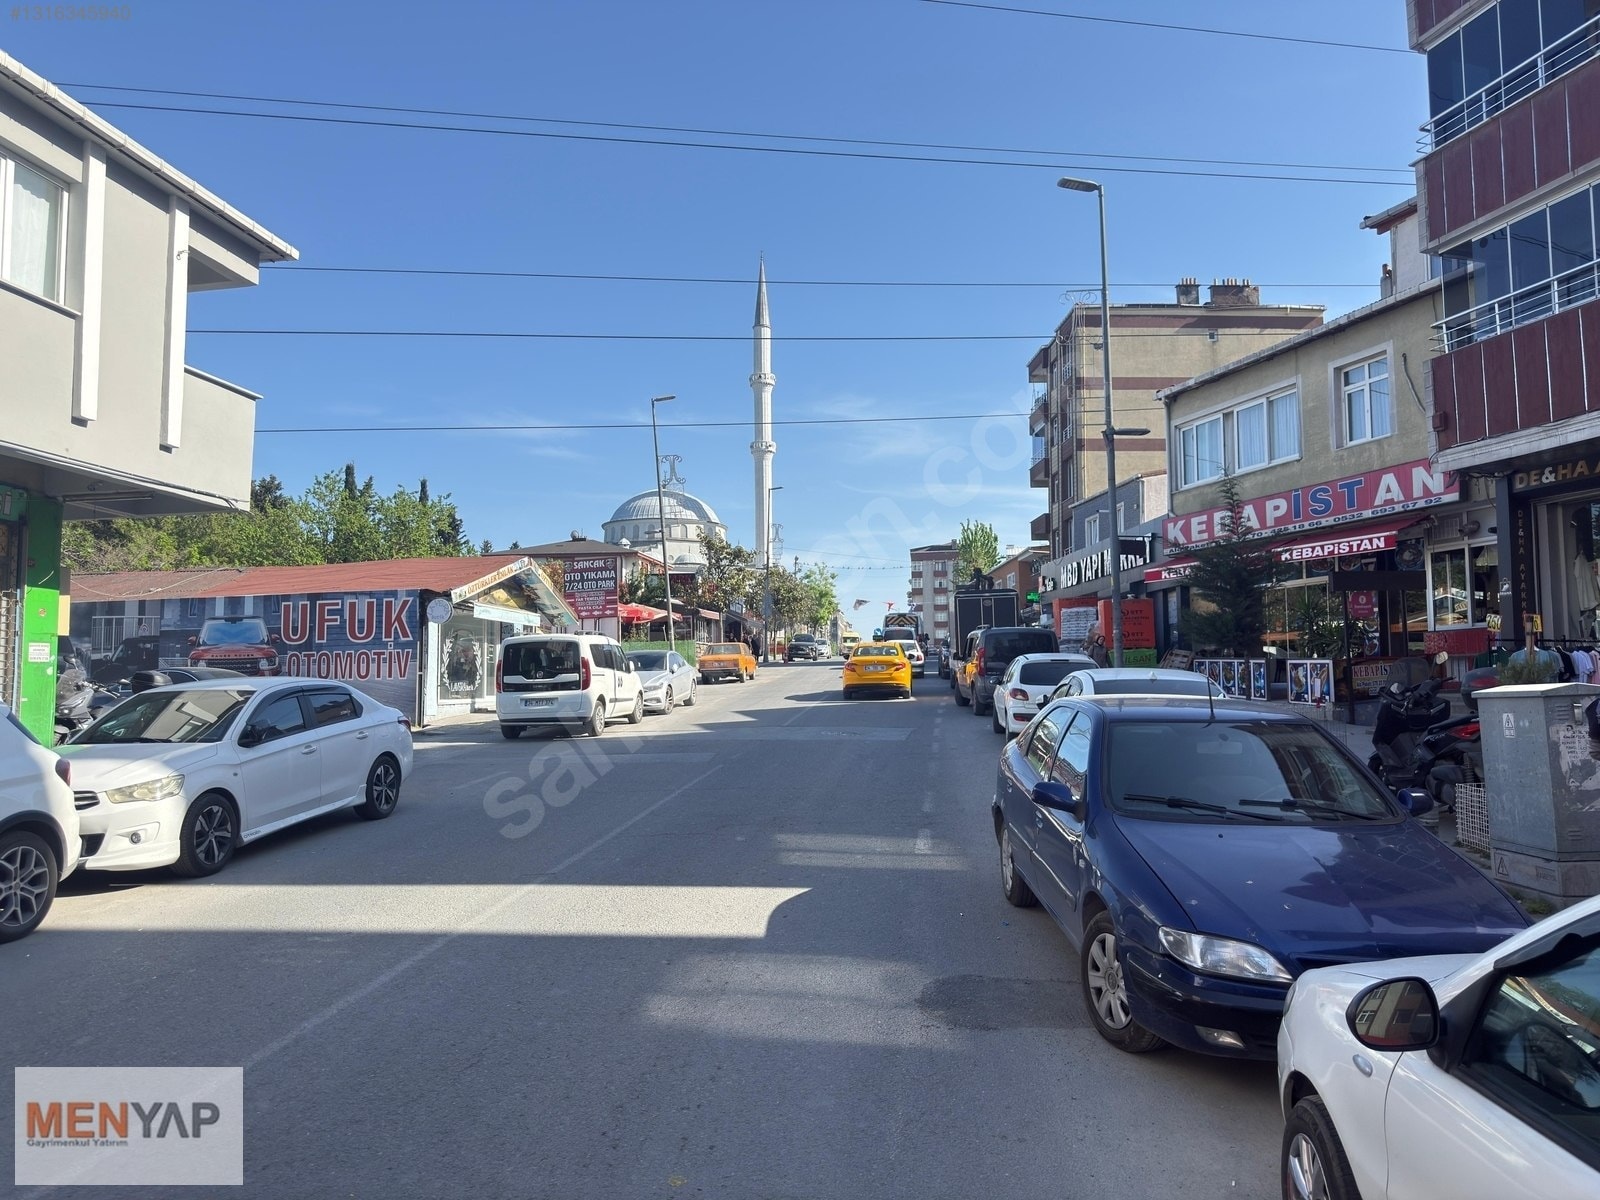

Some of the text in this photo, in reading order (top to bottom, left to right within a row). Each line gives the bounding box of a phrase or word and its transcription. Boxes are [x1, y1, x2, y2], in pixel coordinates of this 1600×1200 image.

[1515, 460, 1590, 490] DE&HA
[1308, 519, 1322, 528] 66
[1333, 512, 1364, 522] 0532
[1371, 505, 1396, 516] 693
[1401, 501, 1418, 510] 67
[1424, 496, 1443, 505] 92
[1280, 536, 1385, 561] KEBAPİSTAN
[564, 570, 616, 581] OTO YIKAMA
[573, 560, 605, 569] SANCAK
[1060, 562, 1078, 589] MBD
[1080, 552, 1102, 583] YAPI
[565, 580, 615, 590] 7/24 OTO PARK
[280, 597, 414, 645] UFUK
[286, 642, 412, 681] OTOMOTİV
